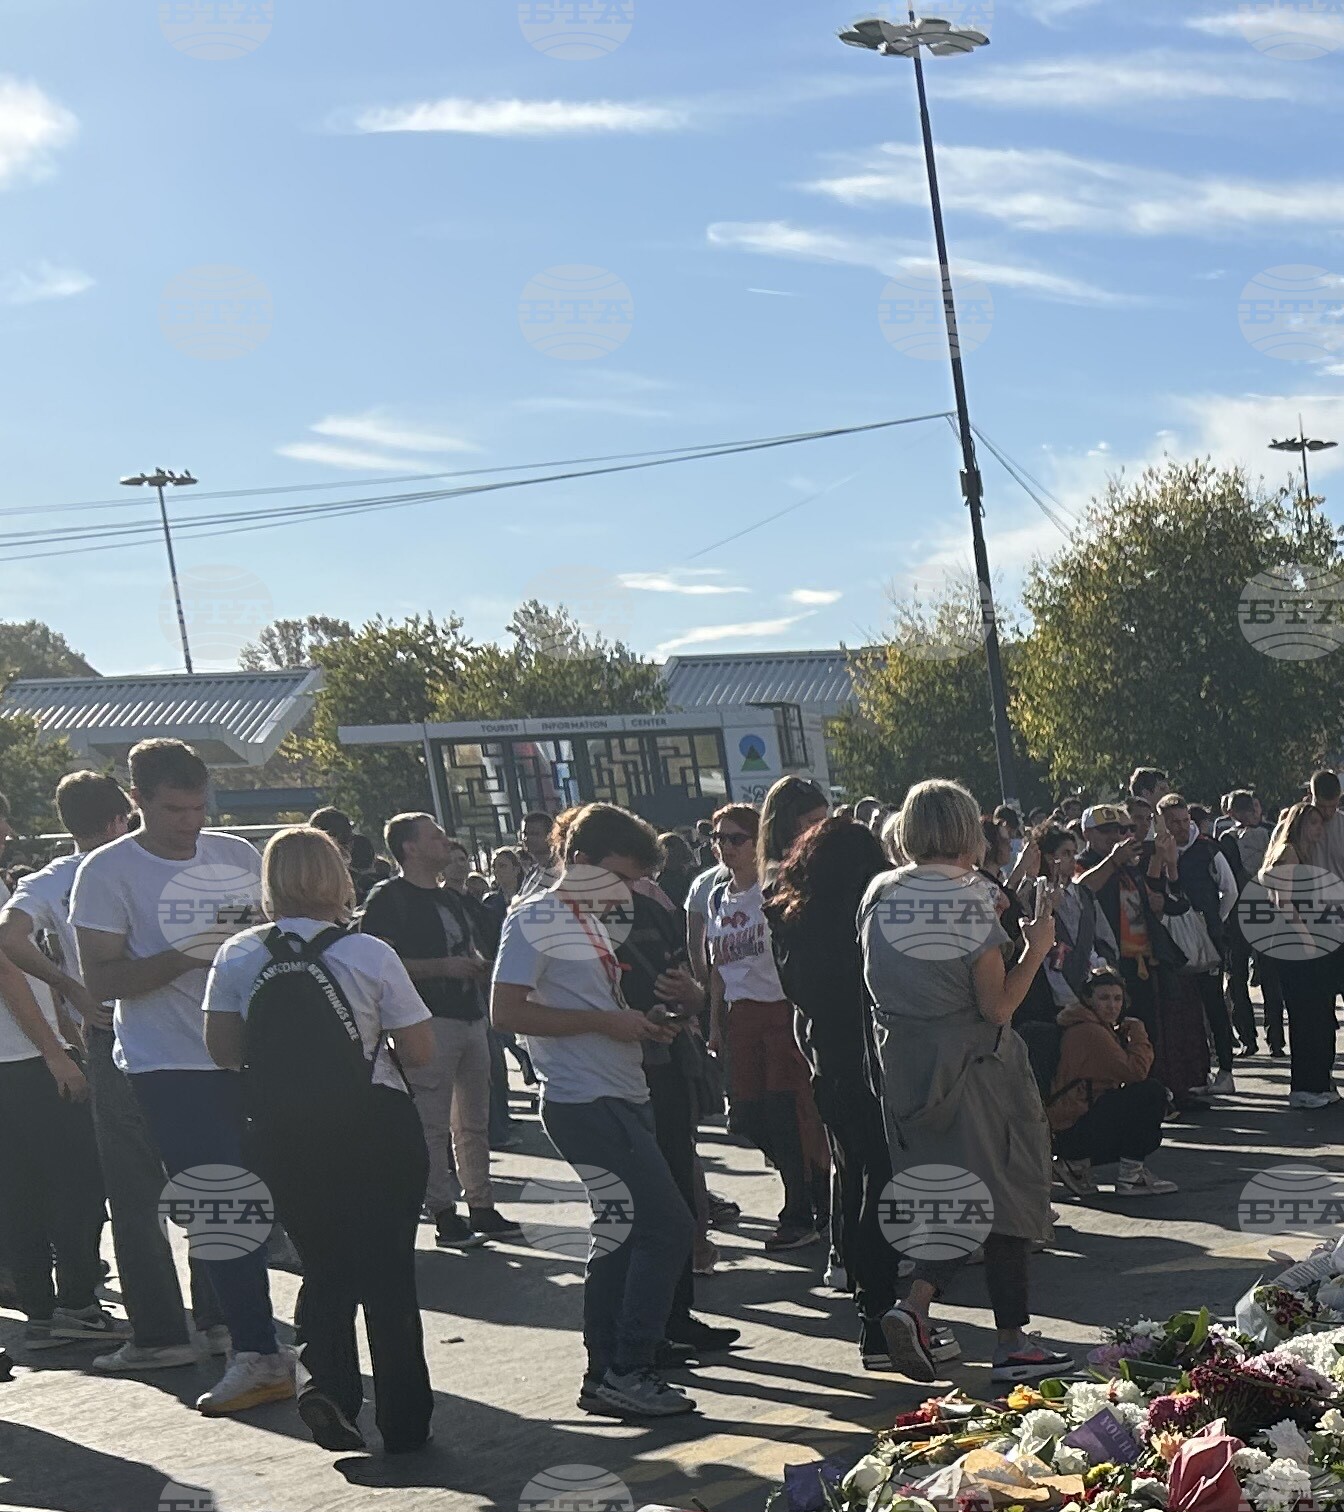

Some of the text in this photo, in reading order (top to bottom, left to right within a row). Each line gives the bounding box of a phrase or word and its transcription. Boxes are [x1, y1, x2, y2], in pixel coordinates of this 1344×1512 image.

[481, 717, 667, 734] TOURIST INFORMATION CENTER
[322, 982, 350, 1021] THINGS
